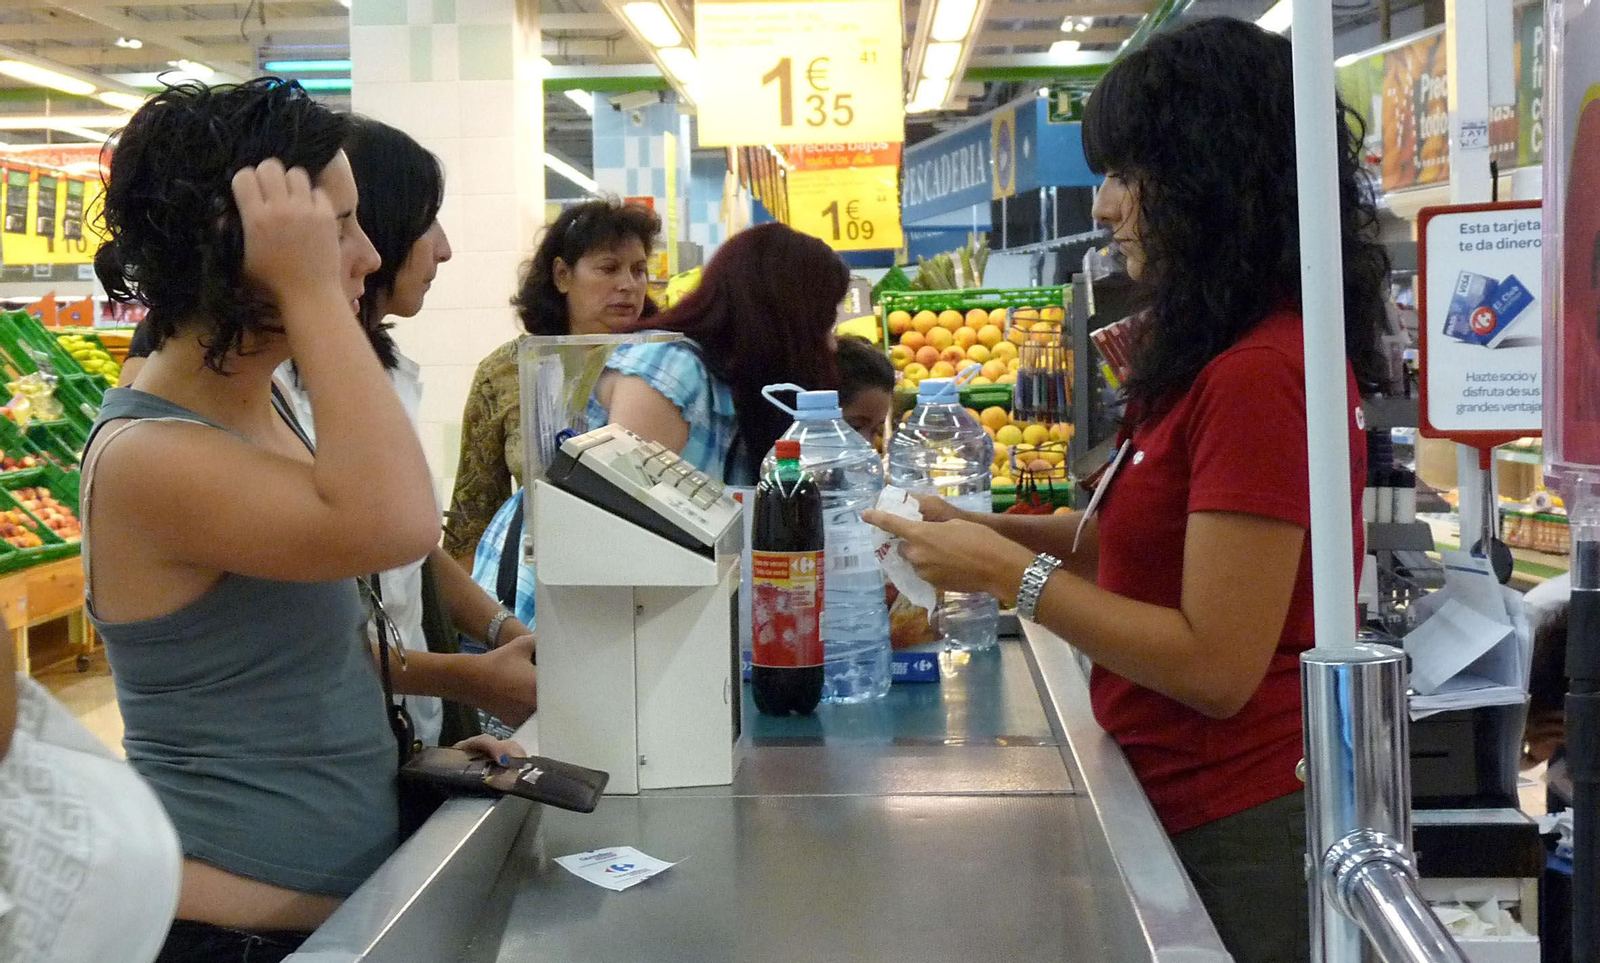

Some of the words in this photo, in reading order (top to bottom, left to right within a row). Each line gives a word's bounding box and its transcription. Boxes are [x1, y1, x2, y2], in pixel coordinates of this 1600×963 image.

[805, 56, 830, 91] €
[762, 57, 793, 127] 1
[805, 94, 855, 127] 35
[847, 139, 889, 154] bajos
[902, 140, 987, 207] PESCADERIA
[845, 199, 861, 220] €
[821, 200, 841, 241] 1
[1460, 223, 1490, 234] Esta
[1493, 220, 1541, 234] tarjeta
[846, 220, 874, 241] 09
[1459, 241, 1473, 251] te
[1476, 239, 1493, 251] da
[1496, 237, 1542, 250] dinero
[1459, 275, 1471, 293] VISA
[1466, 372, 1498, 382] Hazte
[1500, 371, 1529, 382] socio
[1530, 372, 1538, 383] y
[1463, 386, 1504, 397] disfruta
[1506, 387, 1520, 396] de
[1522, 387, 1541, 397] sus
[1456, 402, 1500, 415] grandes
